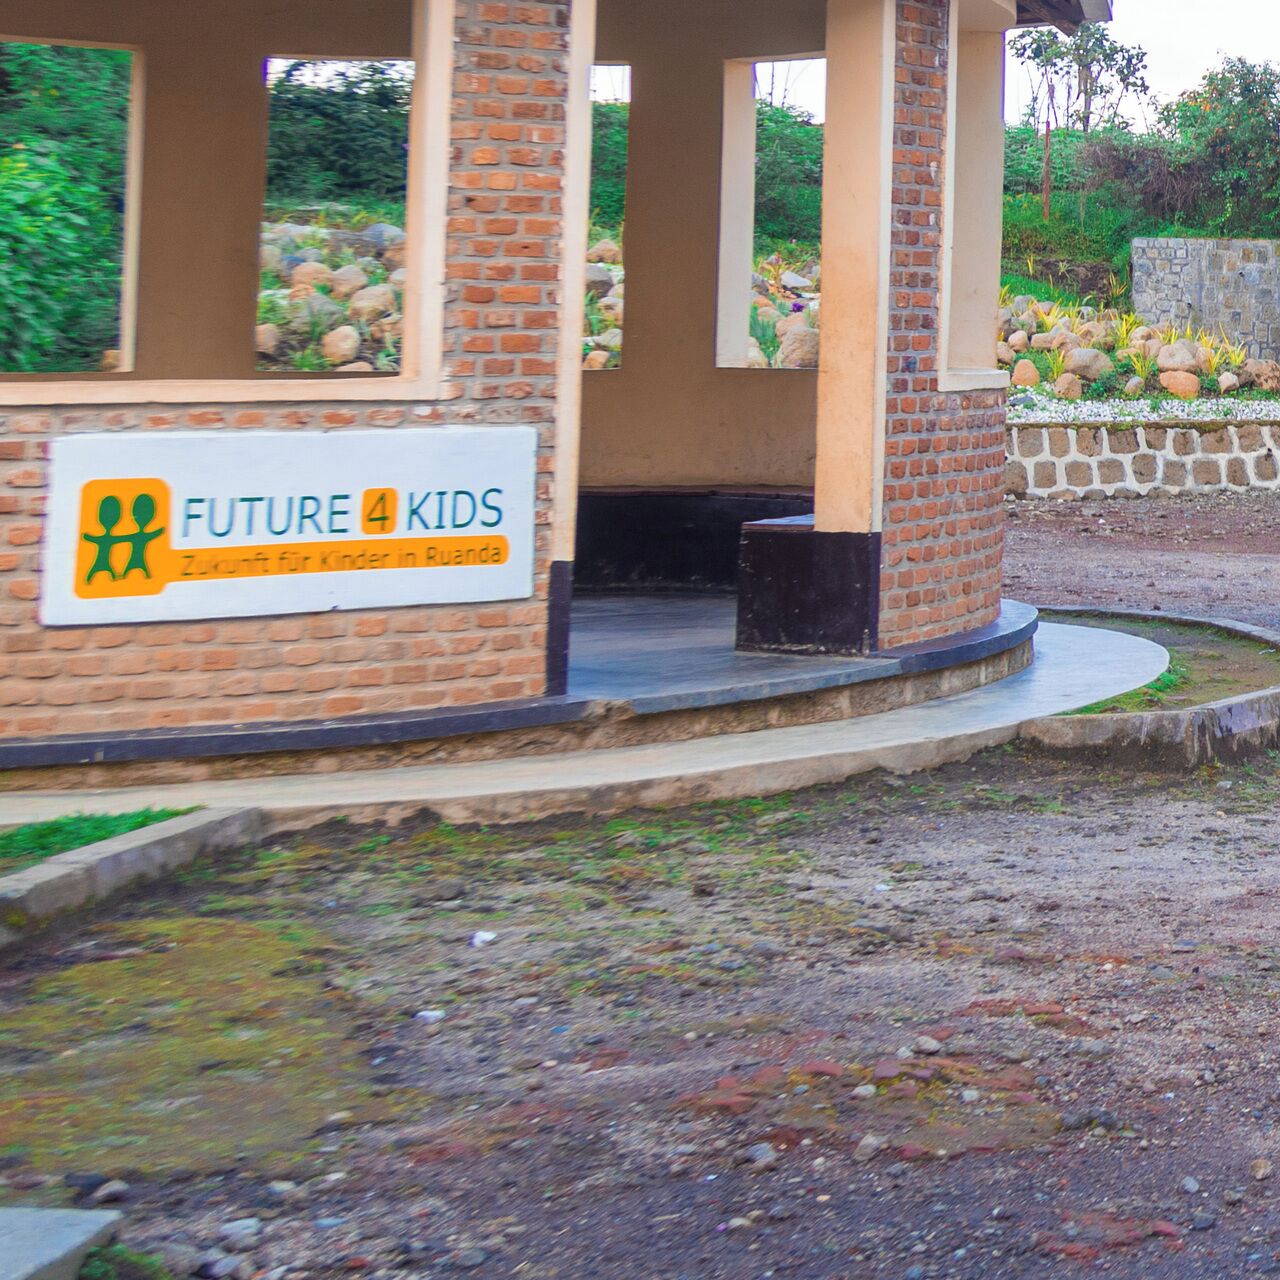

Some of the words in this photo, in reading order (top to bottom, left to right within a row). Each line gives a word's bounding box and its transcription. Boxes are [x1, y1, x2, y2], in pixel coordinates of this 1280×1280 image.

[182, 493, 351, 538] FUTURE
[366, 492, 389, 532] 4
[407, 487, 504, 531] KIDS
[180, 552, 269, 577] Zukunft
[278, 550, 311, 572] für
[320, 548, 391, 571] Kinder
[397, 547, 417, 567] in
[425, 544, 502, 567] Ruanda
